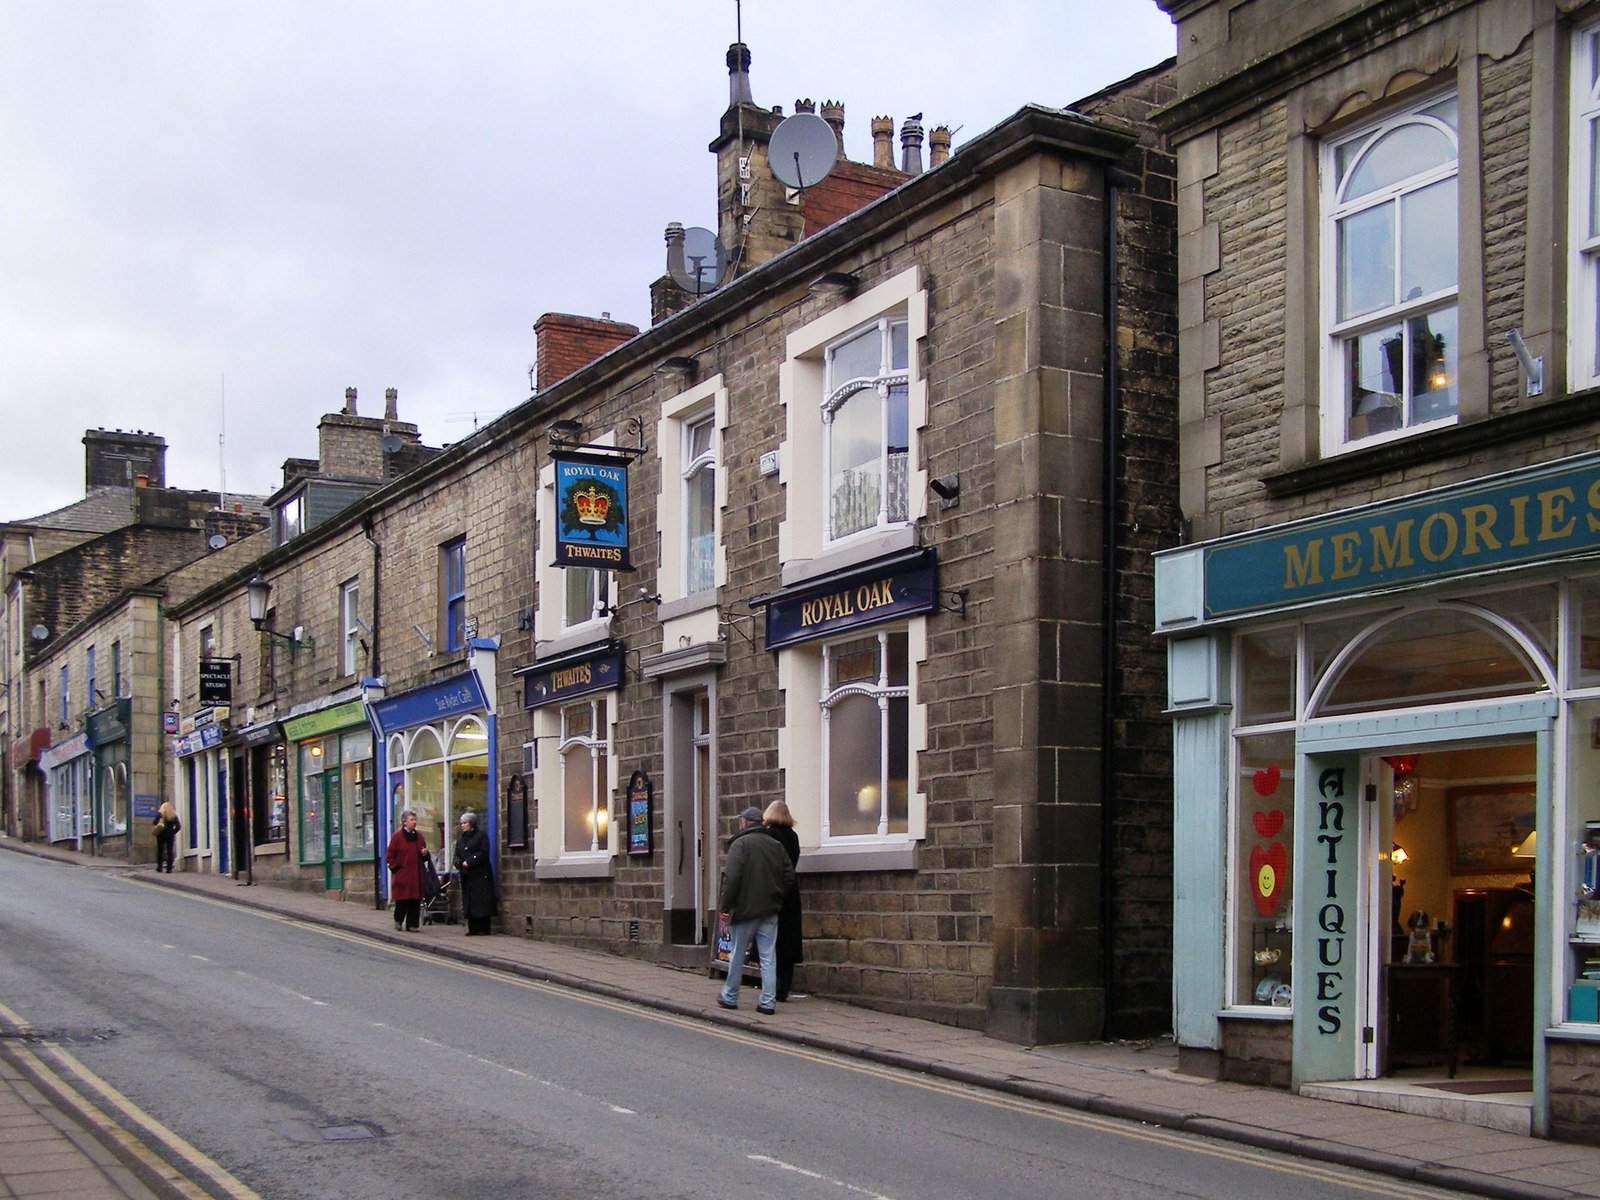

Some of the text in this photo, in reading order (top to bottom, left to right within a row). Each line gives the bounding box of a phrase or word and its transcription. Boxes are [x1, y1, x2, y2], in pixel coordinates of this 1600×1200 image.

[564, 467, 620, 481] ROYAL OAK
[565, 545, 621, 561] THWAITES
[801, 578, 894, 627] ROYAL OAK
[551, 662, 592, 693] THWAITES
